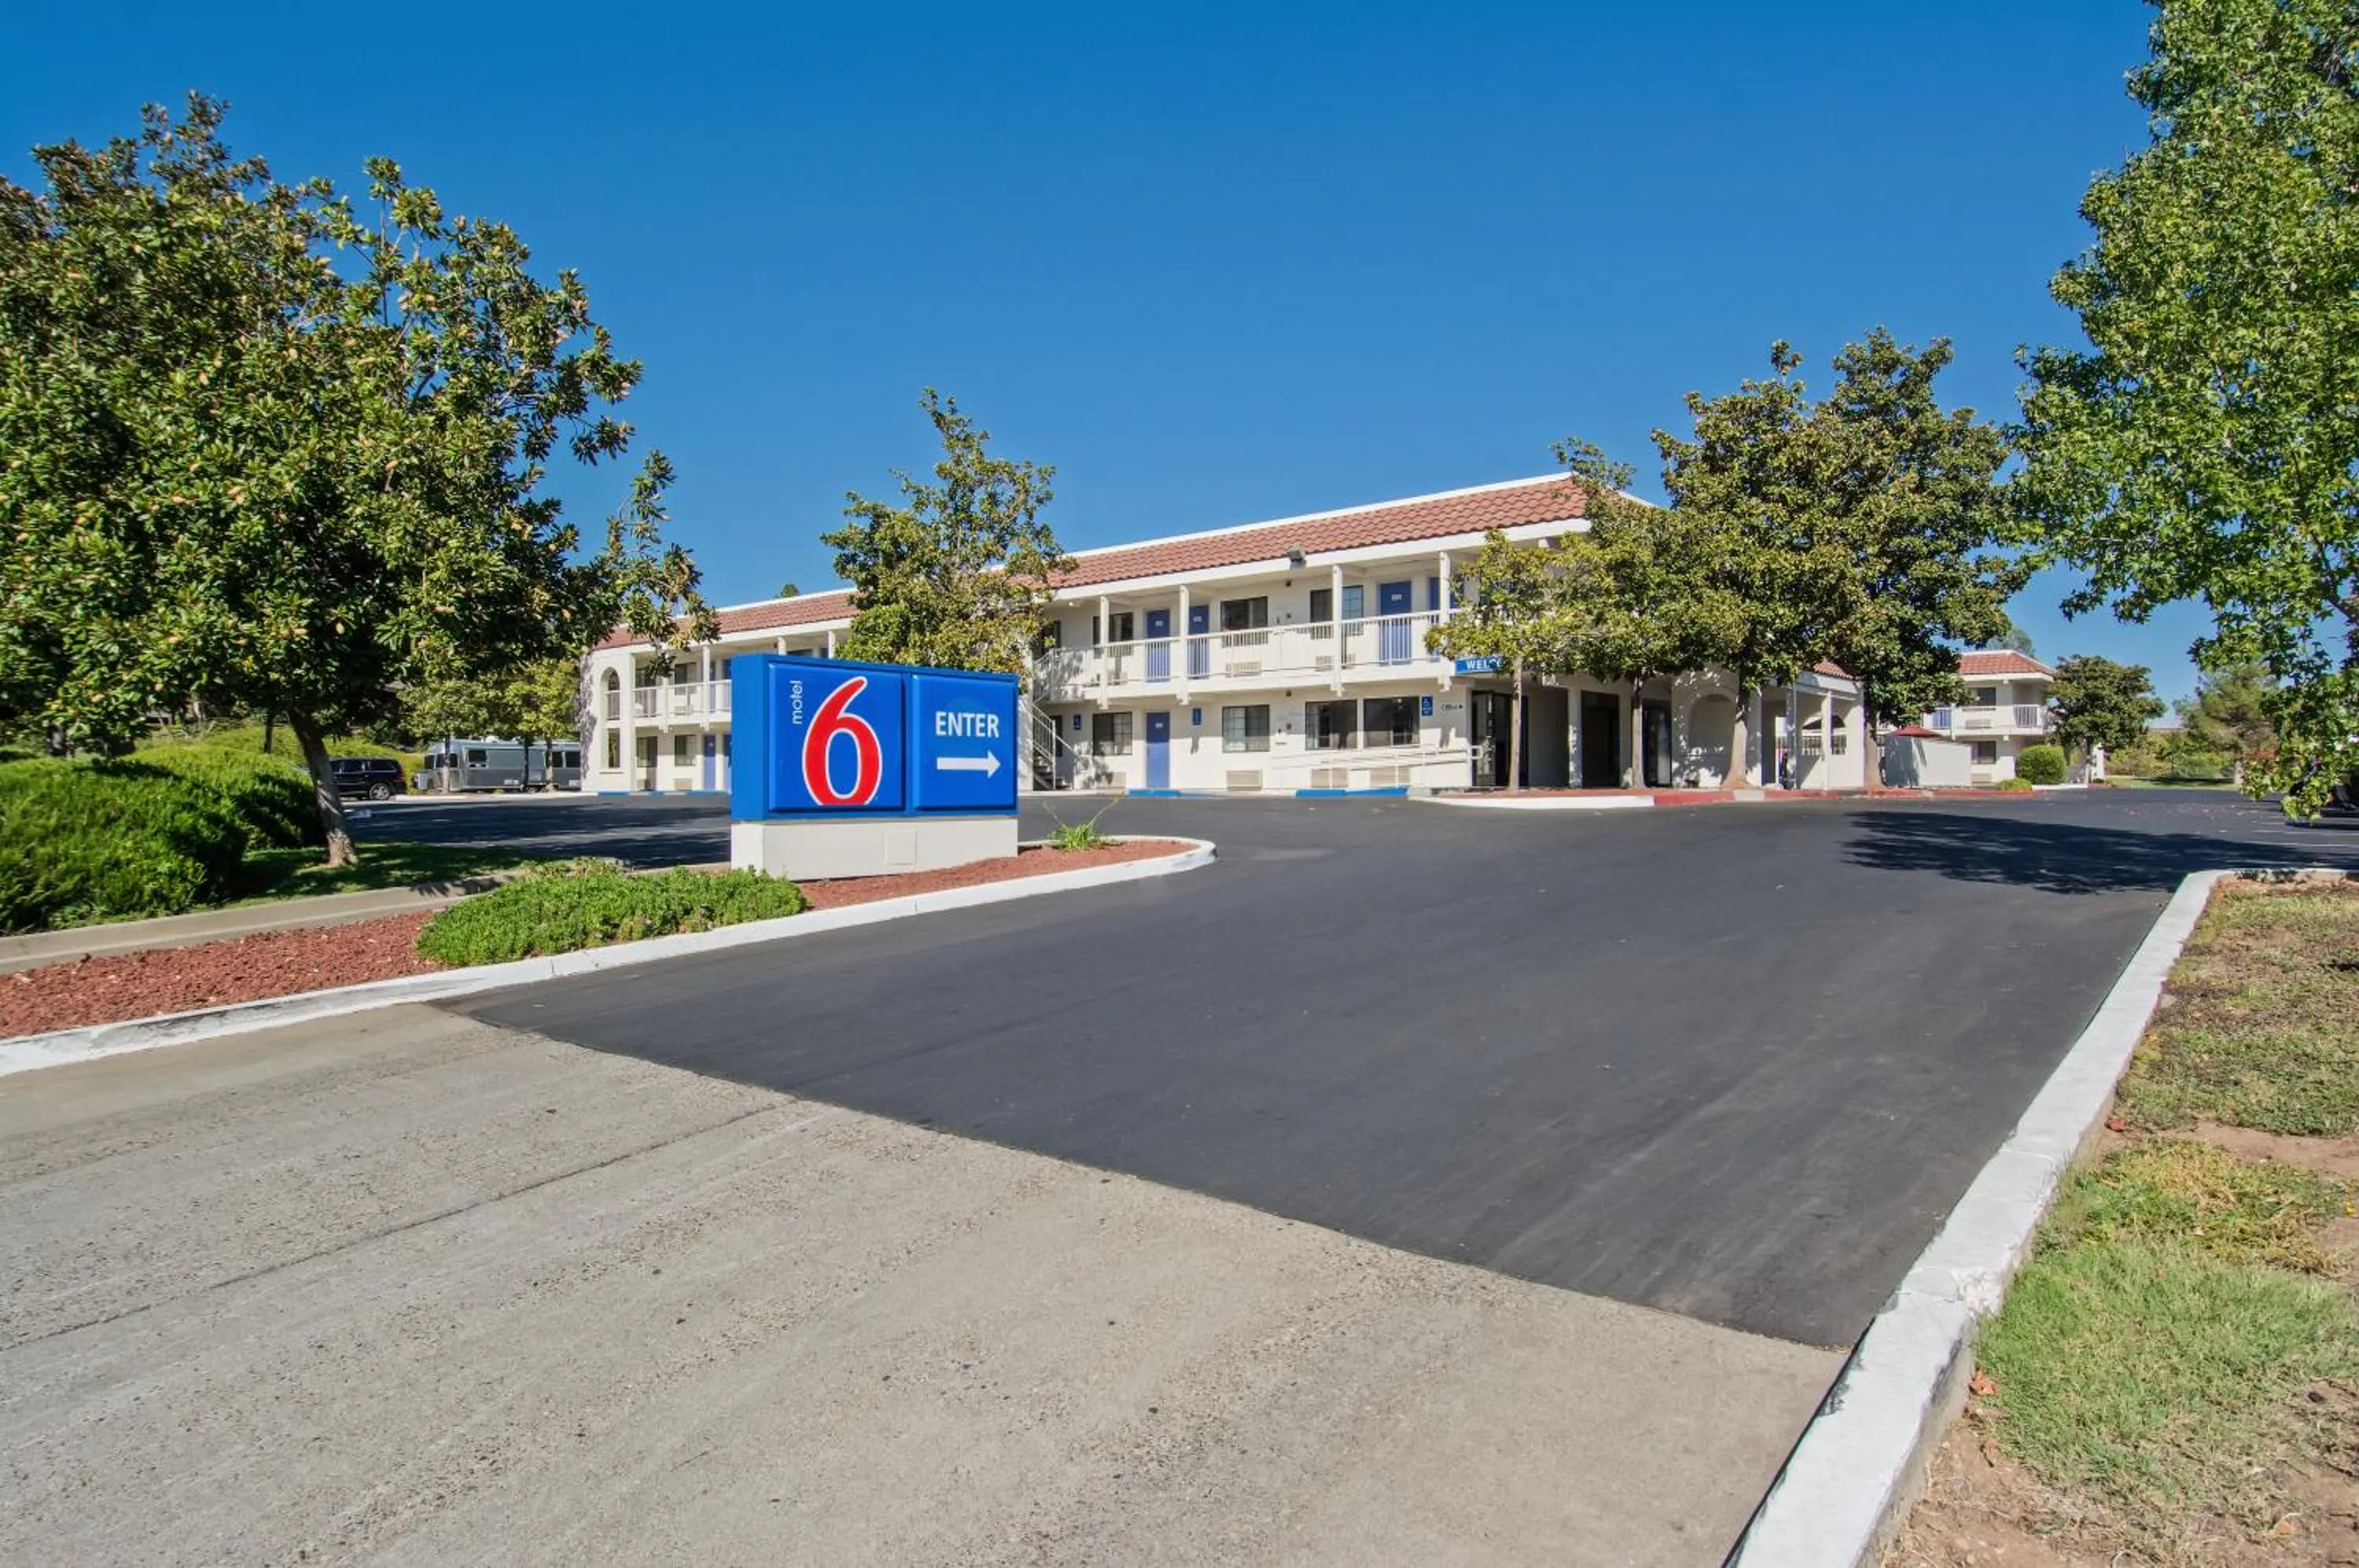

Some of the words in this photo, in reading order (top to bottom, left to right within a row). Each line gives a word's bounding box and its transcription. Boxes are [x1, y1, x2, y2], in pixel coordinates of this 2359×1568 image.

[789, 680, 803, 724] motel
[802, 676, 883, 806] 6
[935, 711, 999, 738] ENTER
